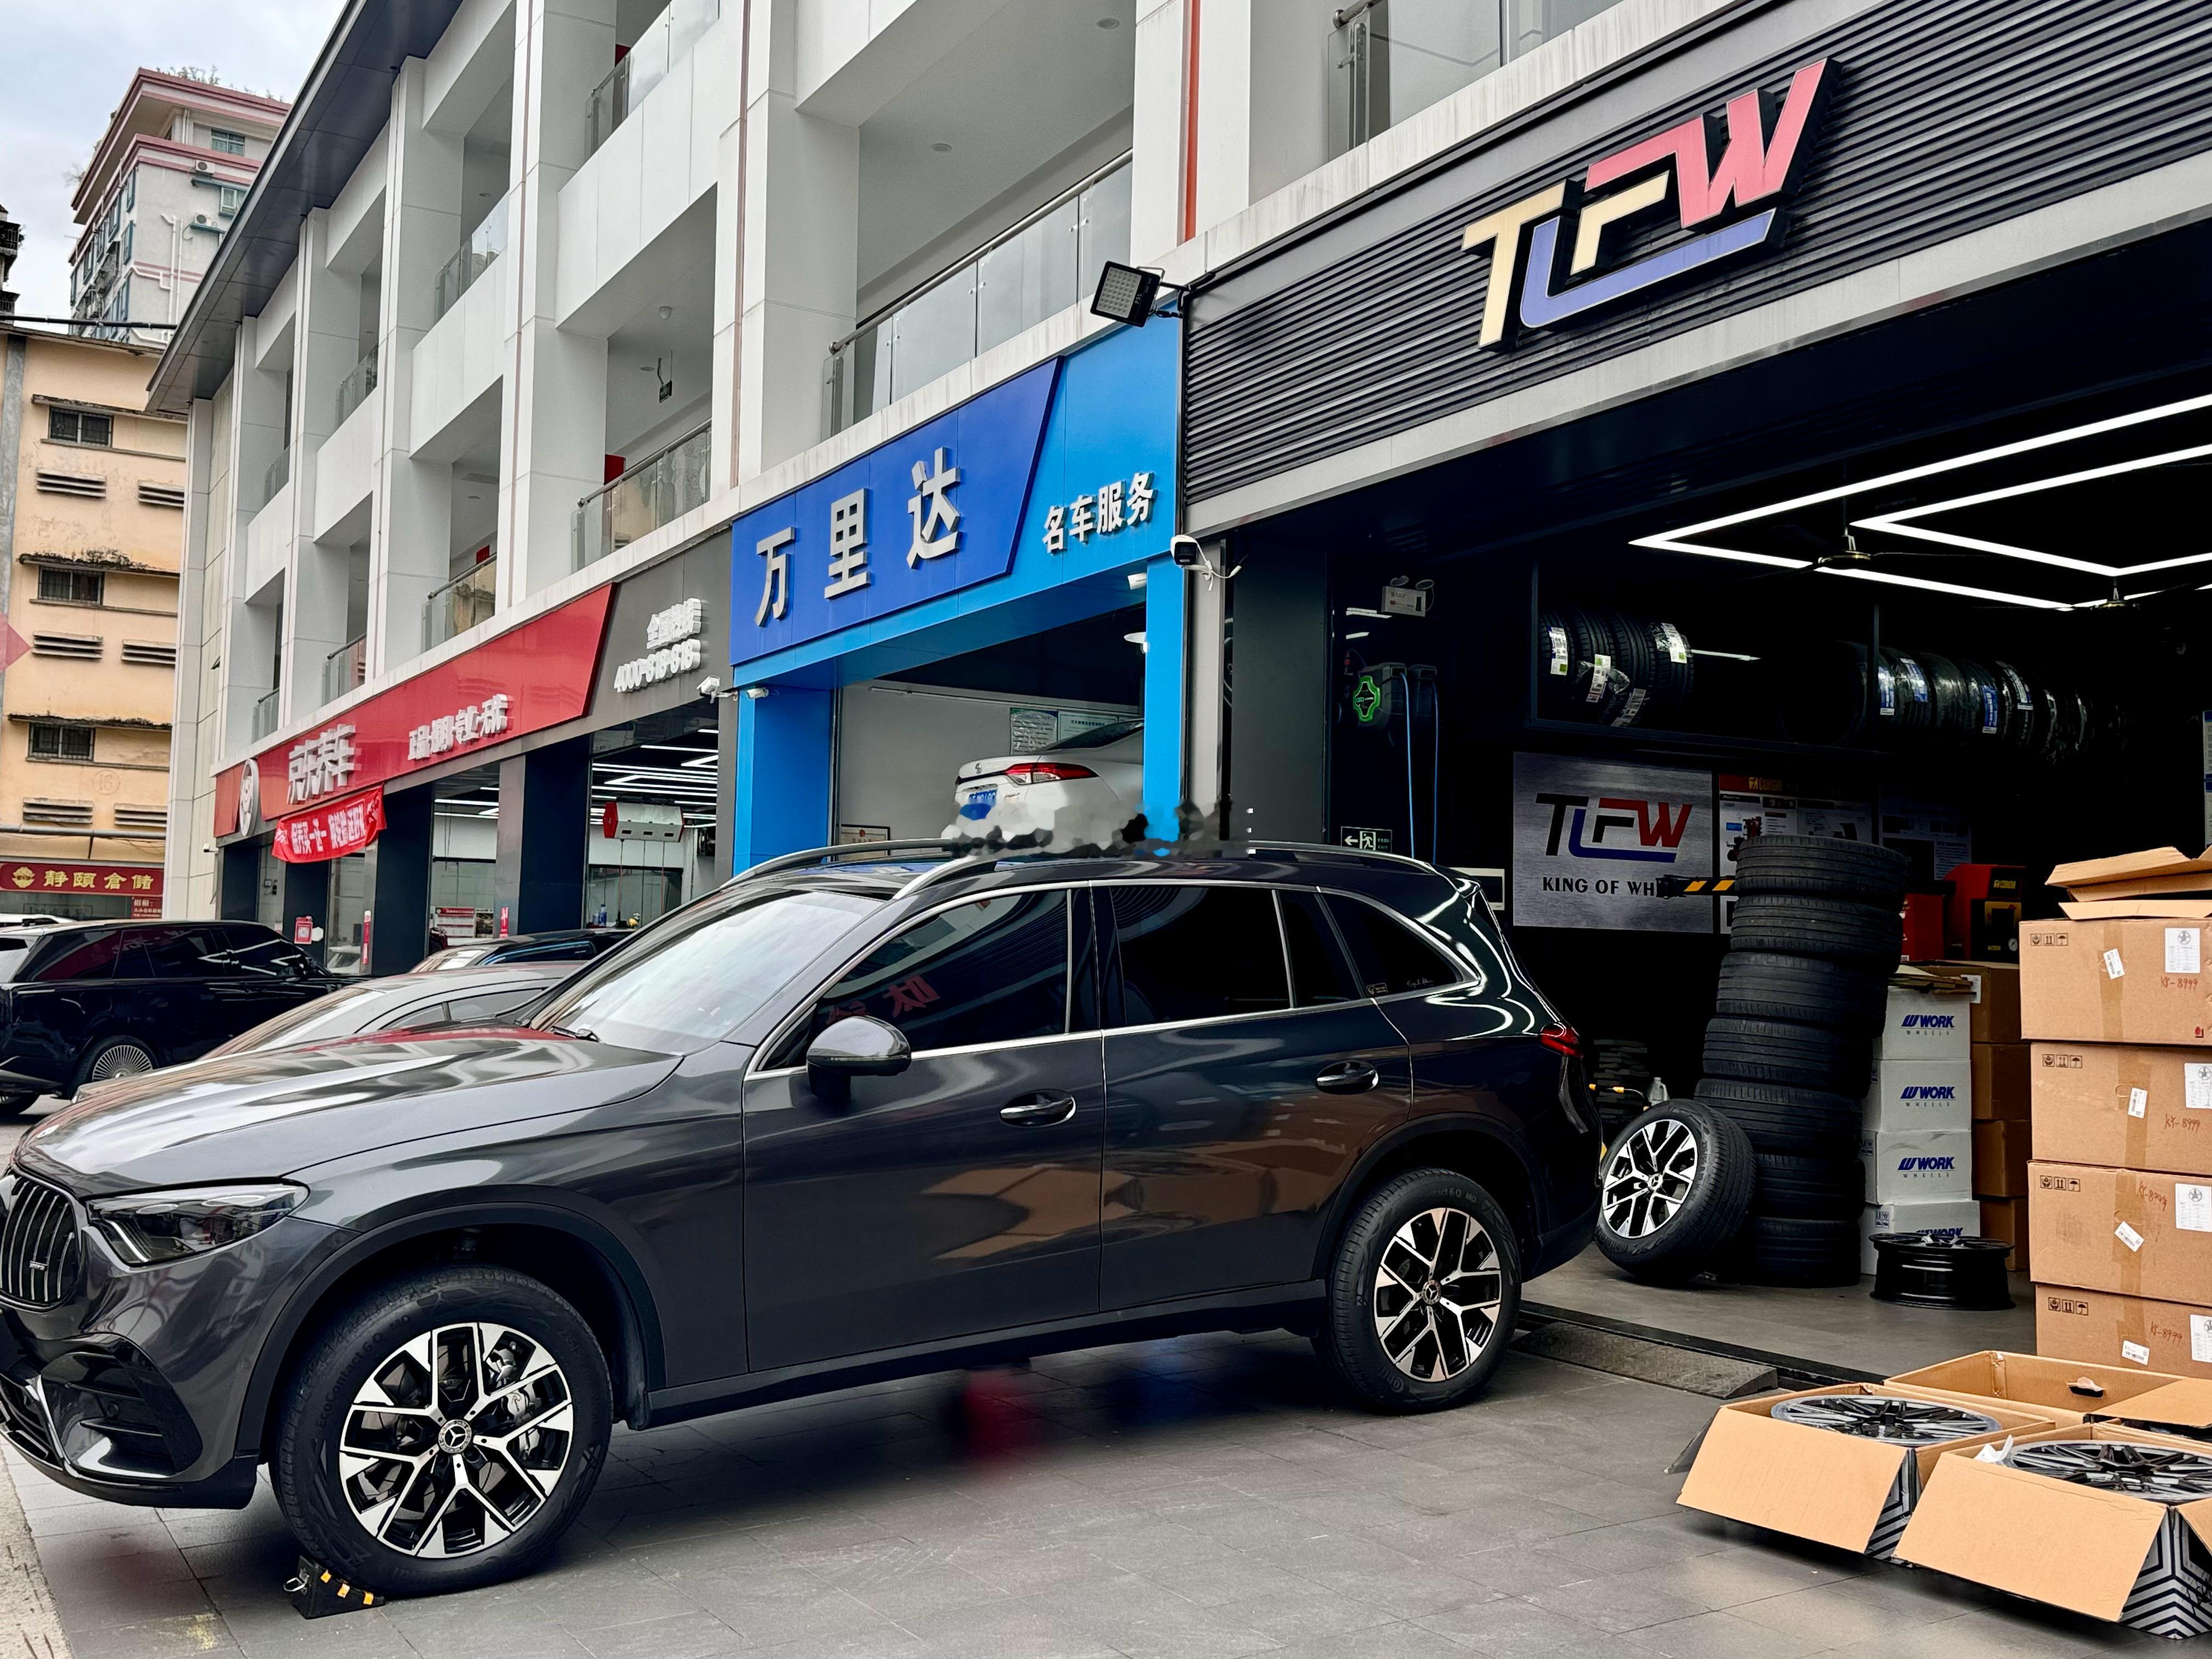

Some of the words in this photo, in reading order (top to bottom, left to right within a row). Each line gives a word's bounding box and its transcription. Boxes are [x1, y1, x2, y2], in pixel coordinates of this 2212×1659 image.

[1042, 471, 1156, 554] 名车服务
[755, 445, 962, 627] 万里达
[1543, 877, 1588, 894] KING
[1595, 879, 1620, 895] OF
[1920, 1015, 1955, 1028] WORK
[1919, 1086, 1955, 1099] WORK
[1917, 1156, 1955, 1170] WORK
